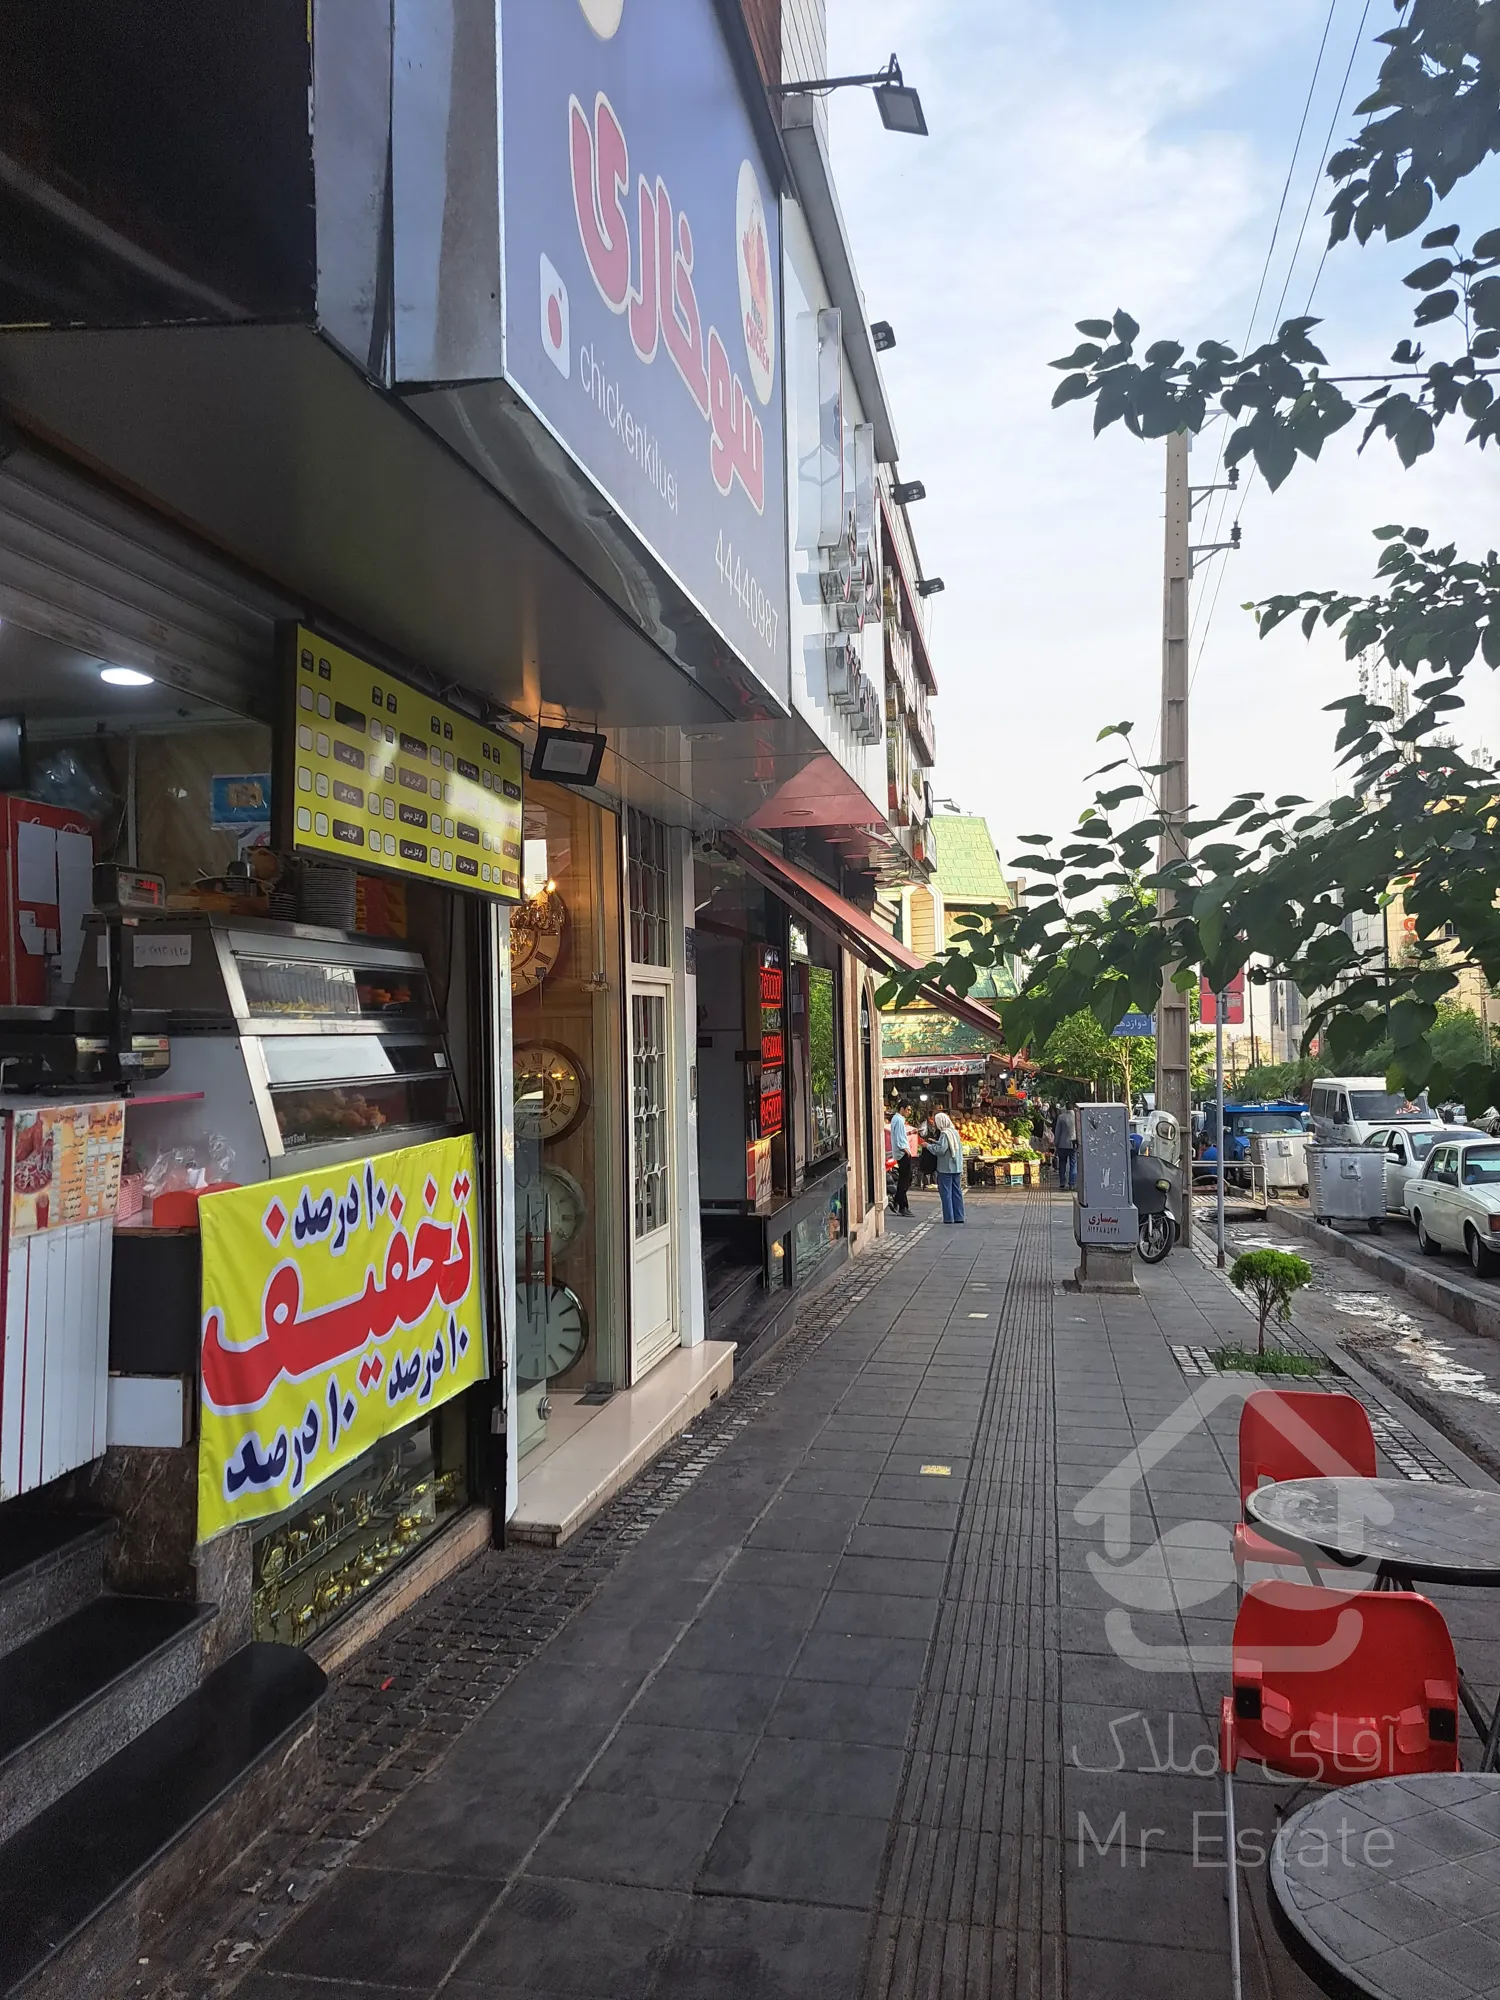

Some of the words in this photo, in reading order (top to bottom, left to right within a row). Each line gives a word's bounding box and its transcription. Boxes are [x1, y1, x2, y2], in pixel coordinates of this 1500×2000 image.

[568, 90, 764, 517] سوخاری
[715, 528, 778, 655] 44440987
[293, 1177, 361, 1255] درصد
[202, 1171, 471, 1408] تخفیف
[388, 1331, 446, 1403] درصد
[226, 1405, 320, 1493] درصد
